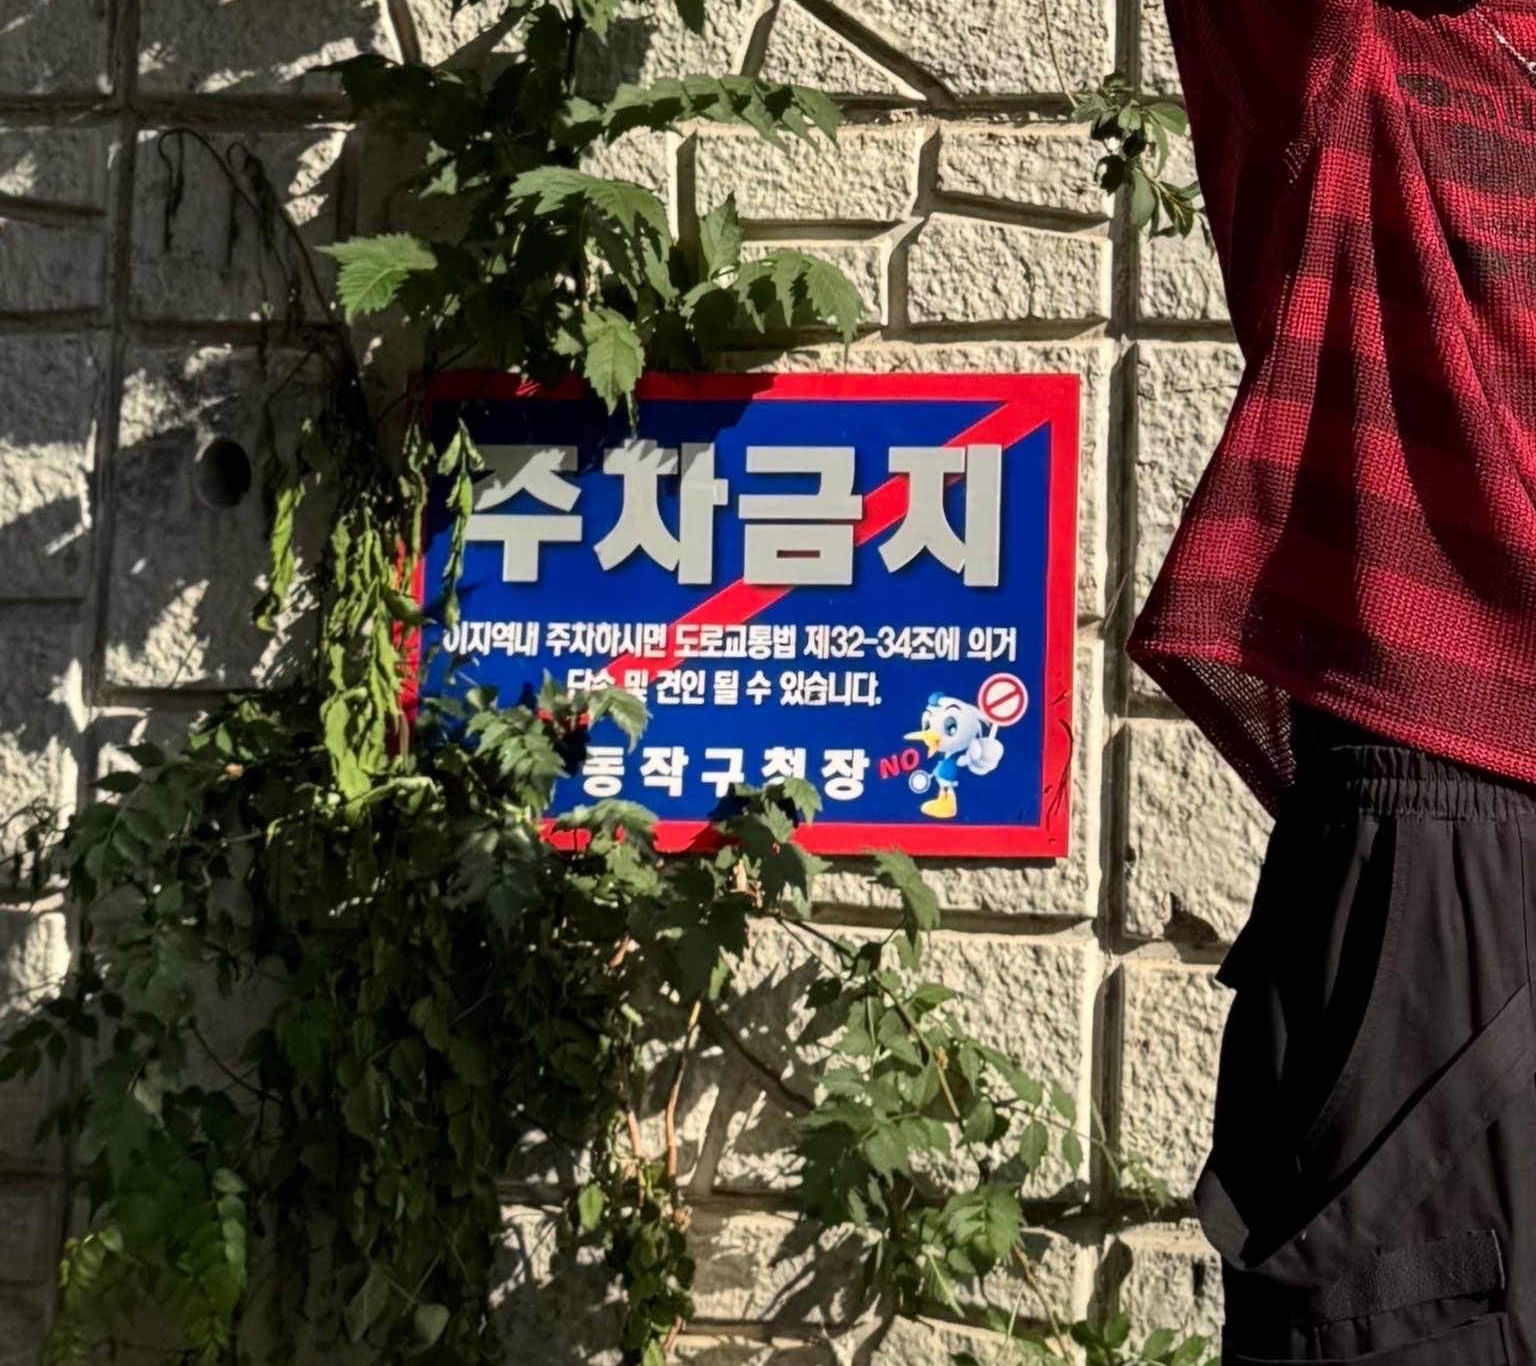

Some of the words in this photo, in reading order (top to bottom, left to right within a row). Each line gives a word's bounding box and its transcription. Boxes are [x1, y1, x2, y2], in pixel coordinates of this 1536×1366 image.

[463, 438, 1003, 587] 주차금지
[545, 621, 667, 659] 주차하시면
[674, 623, 797, 660] 도로교통법
[803, 625, 960, 661] 제32-34조에
[967, 626, 1017, 662] 의거
[656, 669, 706, 705] 견인
[713, 669, 740, 705] 될
[746, 669, 772, 706] 수
[779, 670, 882, 707] 있습니다.
[879, 747, 920, 780] NO
